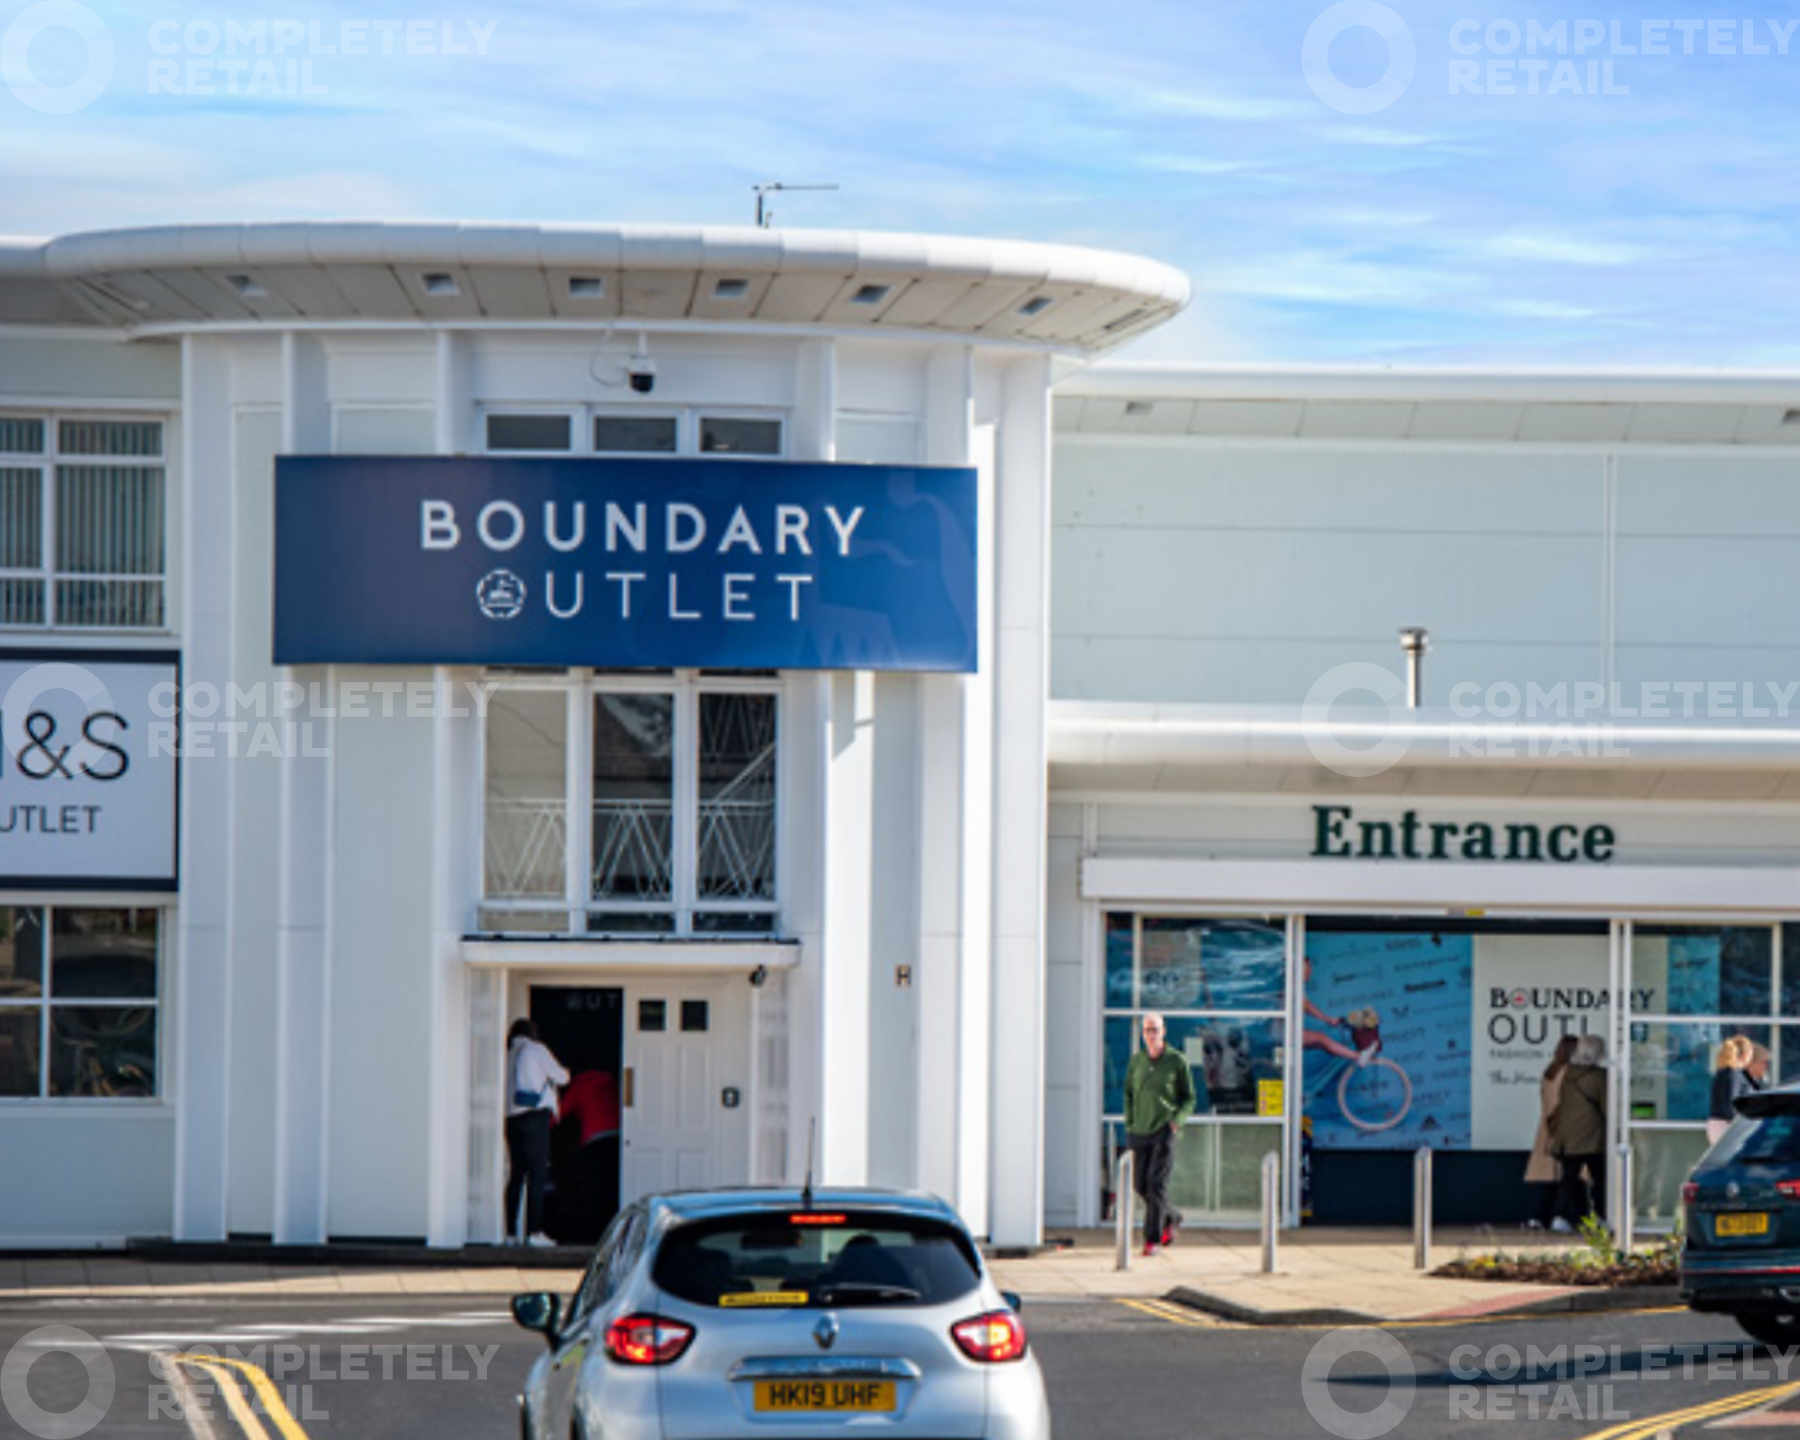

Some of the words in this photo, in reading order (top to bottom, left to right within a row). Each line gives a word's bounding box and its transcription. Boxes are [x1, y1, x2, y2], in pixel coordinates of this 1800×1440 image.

[421, 500, 865, 556] BOUNDARY
[0, 710, 130, 780] &S
[1310, 805, 1615, 862] Entrance
[770, 1384, 826, 1406] HK19
[833, 1384, 880, 1406] UHF
